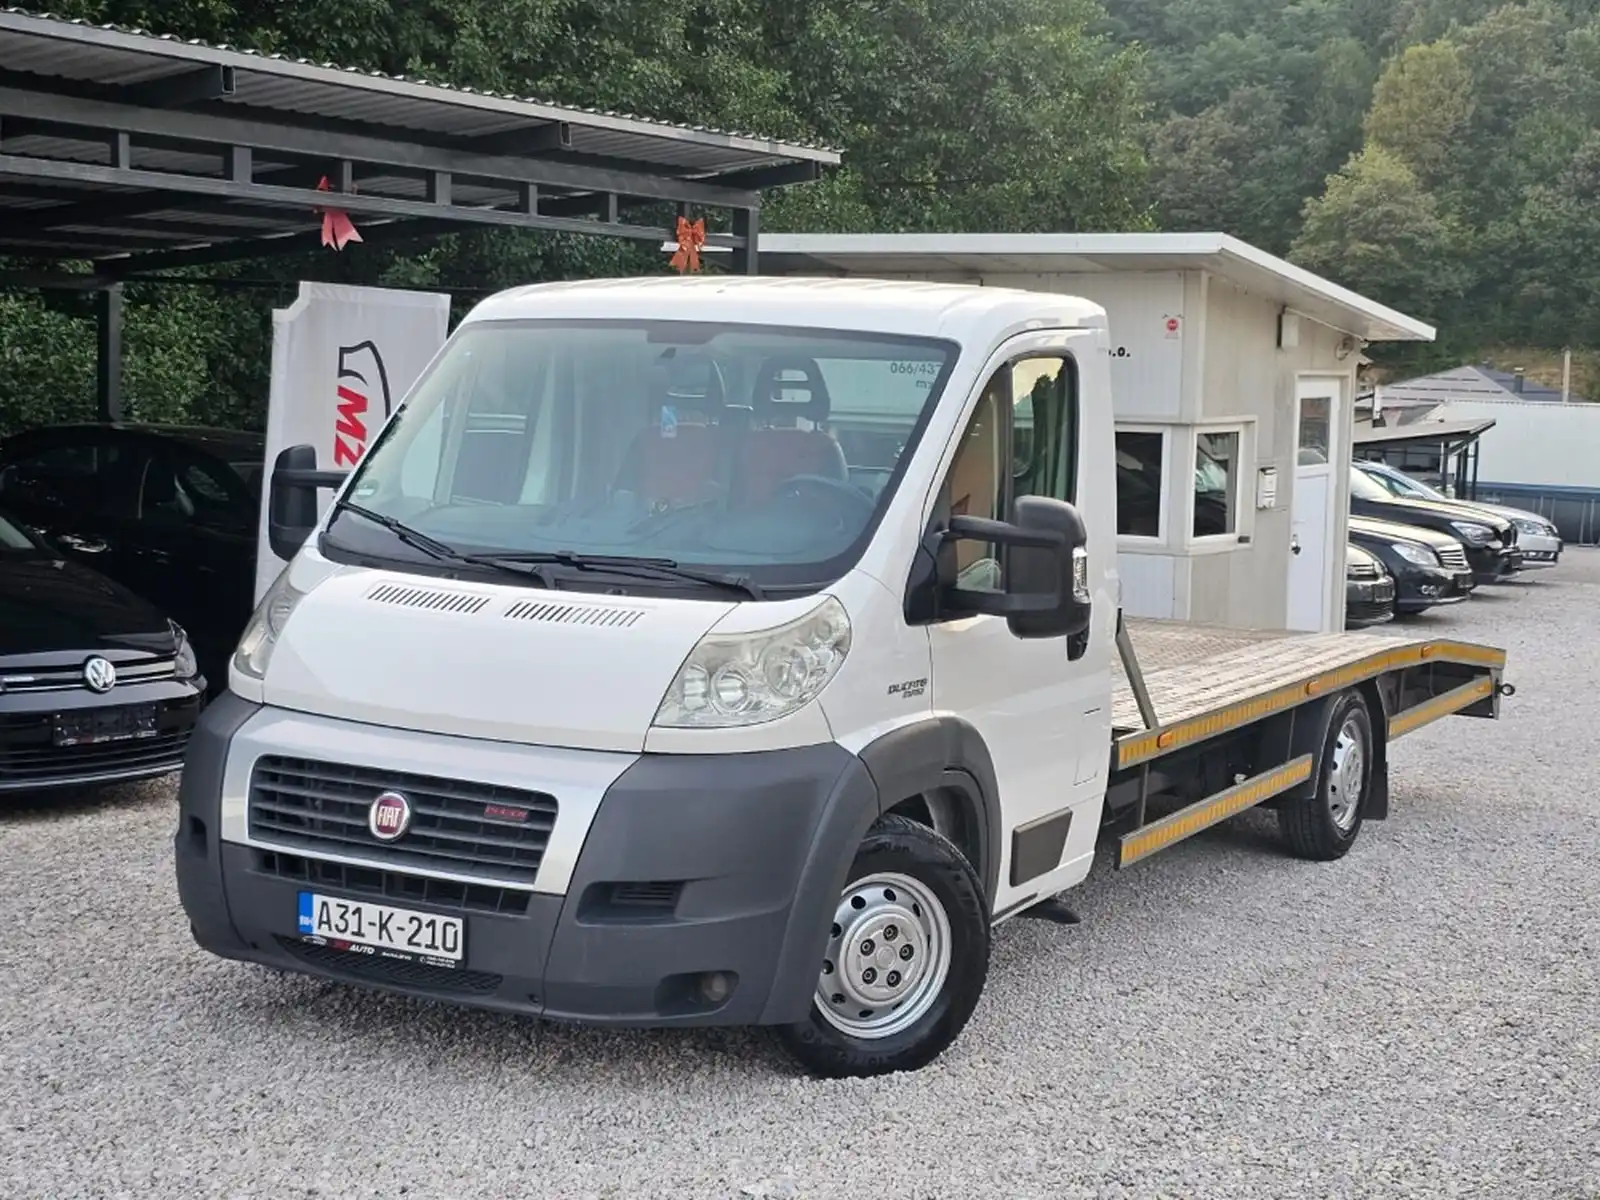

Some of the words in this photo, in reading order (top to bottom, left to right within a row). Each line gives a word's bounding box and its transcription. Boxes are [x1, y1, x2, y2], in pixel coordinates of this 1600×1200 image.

[1107, 346, 1132, 357] .o.
[377, 805, 402, 828] FIAT
[317, 900, 459, 953] A31-K-210
[349, 943, 375, 955] AUTO
